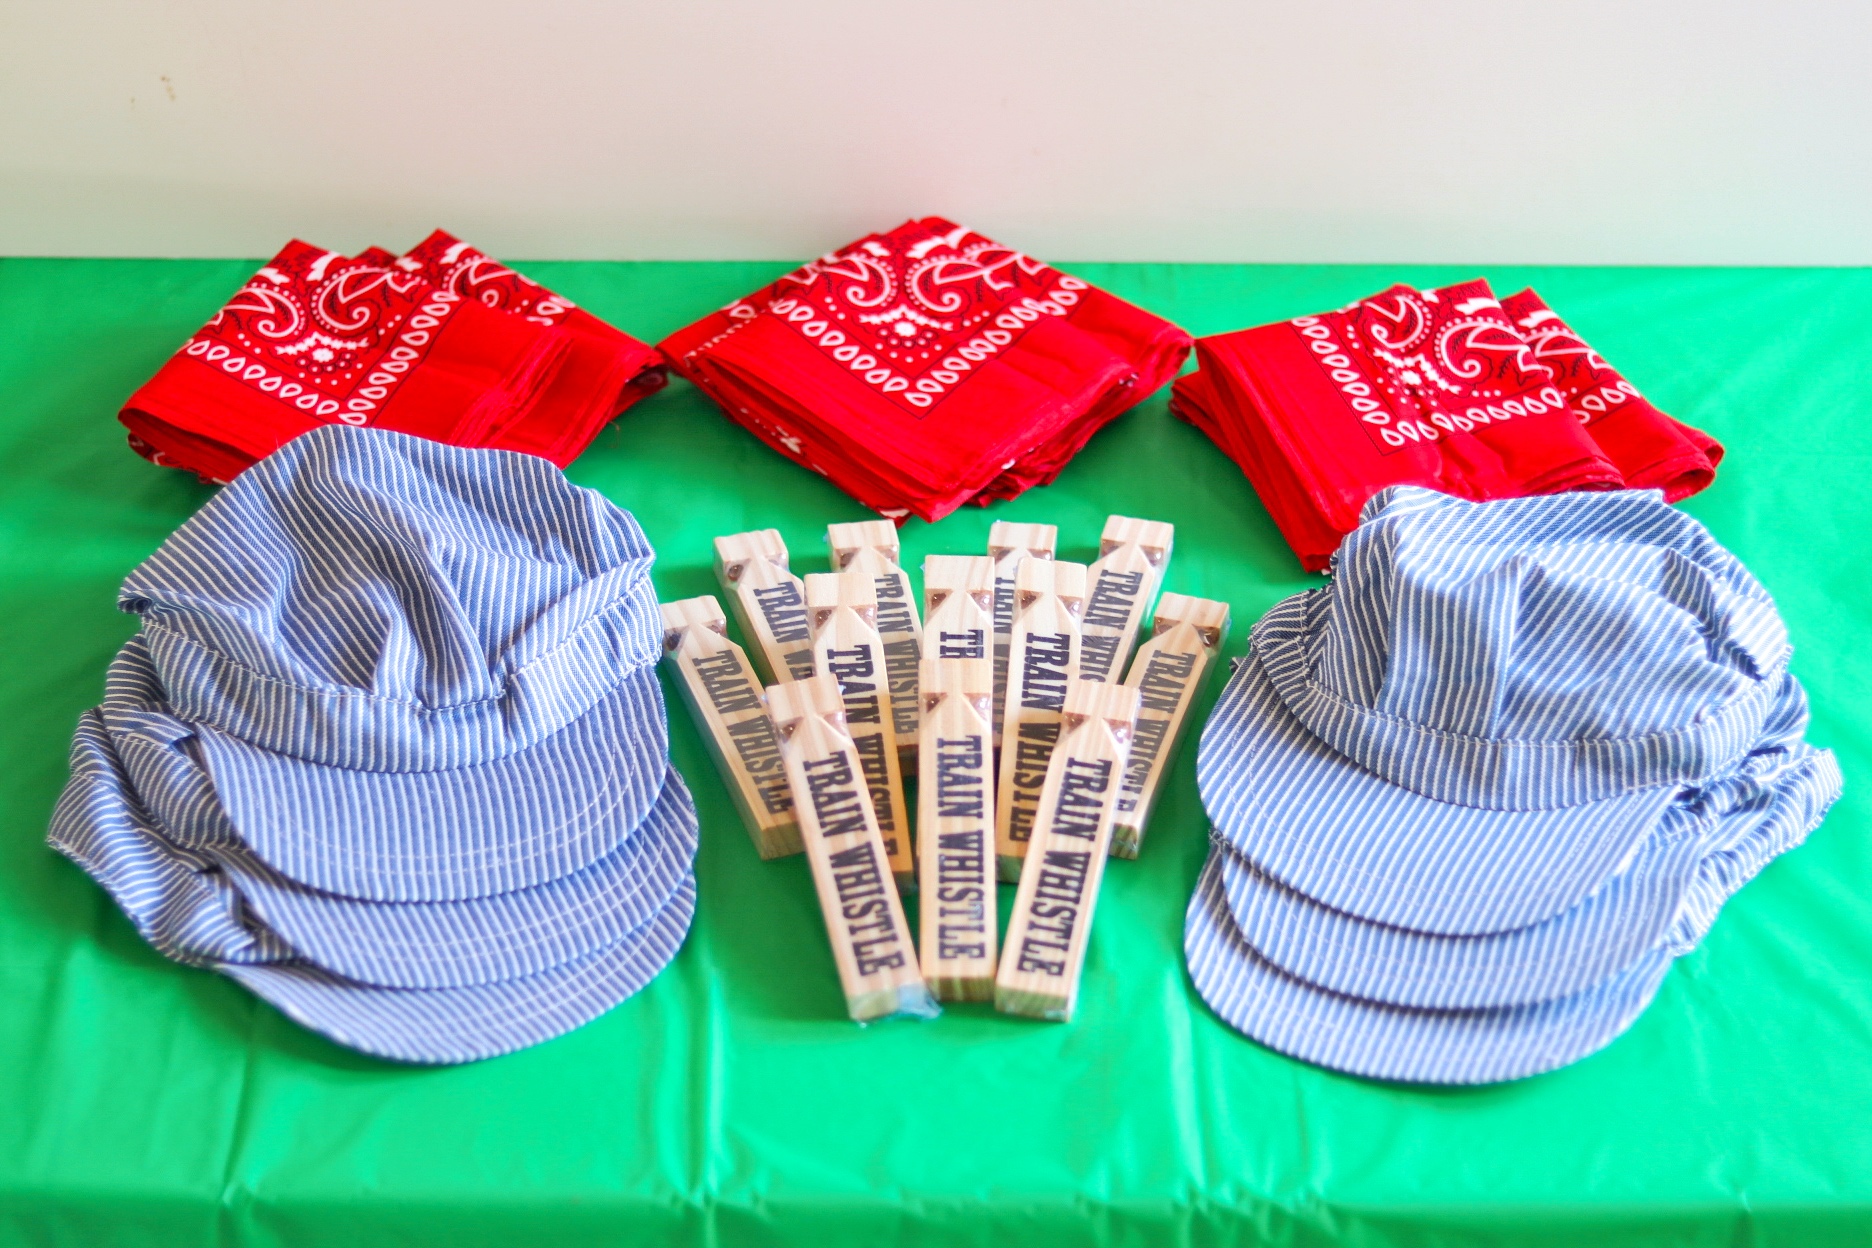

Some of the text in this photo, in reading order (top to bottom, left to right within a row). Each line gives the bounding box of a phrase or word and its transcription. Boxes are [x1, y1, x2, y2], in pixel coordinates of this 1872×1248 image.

[753, 581, 812, 644] TRAIN
[875, 573, 914, 633] TRAIN
[1083, 570, 1143, 630] TRAIN
[692, 649, 762, 714] TRAIN
[827, 644, 881, 724] TRAIN
[1021, 632, 1071, 713] TRAIN
[1139, 650, 1197, 714] TRAIN
[803, 750, 905, 976] TRAIN WHISTLE
[937, 735, 986, 960] TRAIN WHISTLE
[1017, 757, 1113, 977] TRAIN WHISTLE
